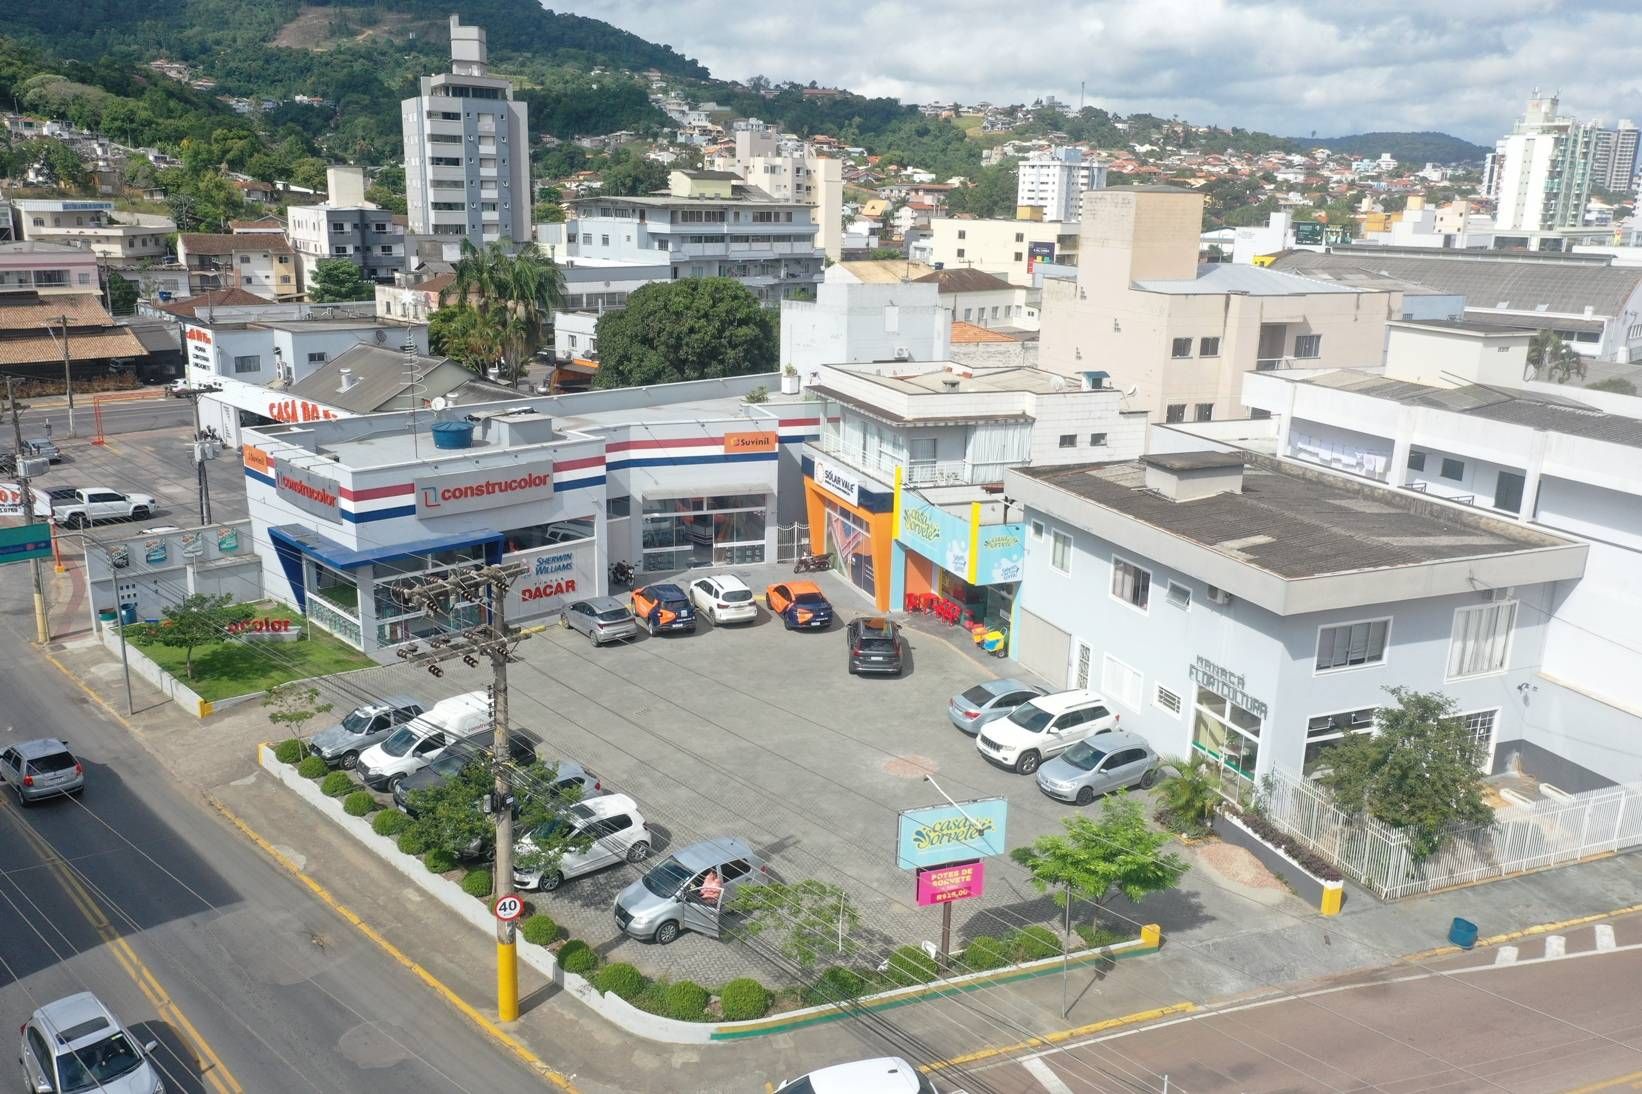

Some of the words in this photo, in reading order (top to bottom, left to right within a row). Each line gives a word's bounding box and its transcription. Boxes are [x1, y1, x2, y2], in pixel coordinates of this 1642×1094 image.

[269, 400, 299, 423] CASA
[741, 437, 769, 446] Suvinil
[283, 476, 337, 508] construcolor
[441, 473, 550, 501] construcolor
[536, 552, 573, 567] SHERWIN
[535, 563, 573, 576] WILLIAMS
[521, 579, 576, 602] DACAR
[1189, 663, 1268, 721] FLORICULTURA
[961, 868, 974, 877] DE
[498, 900, 518, 913] 40
